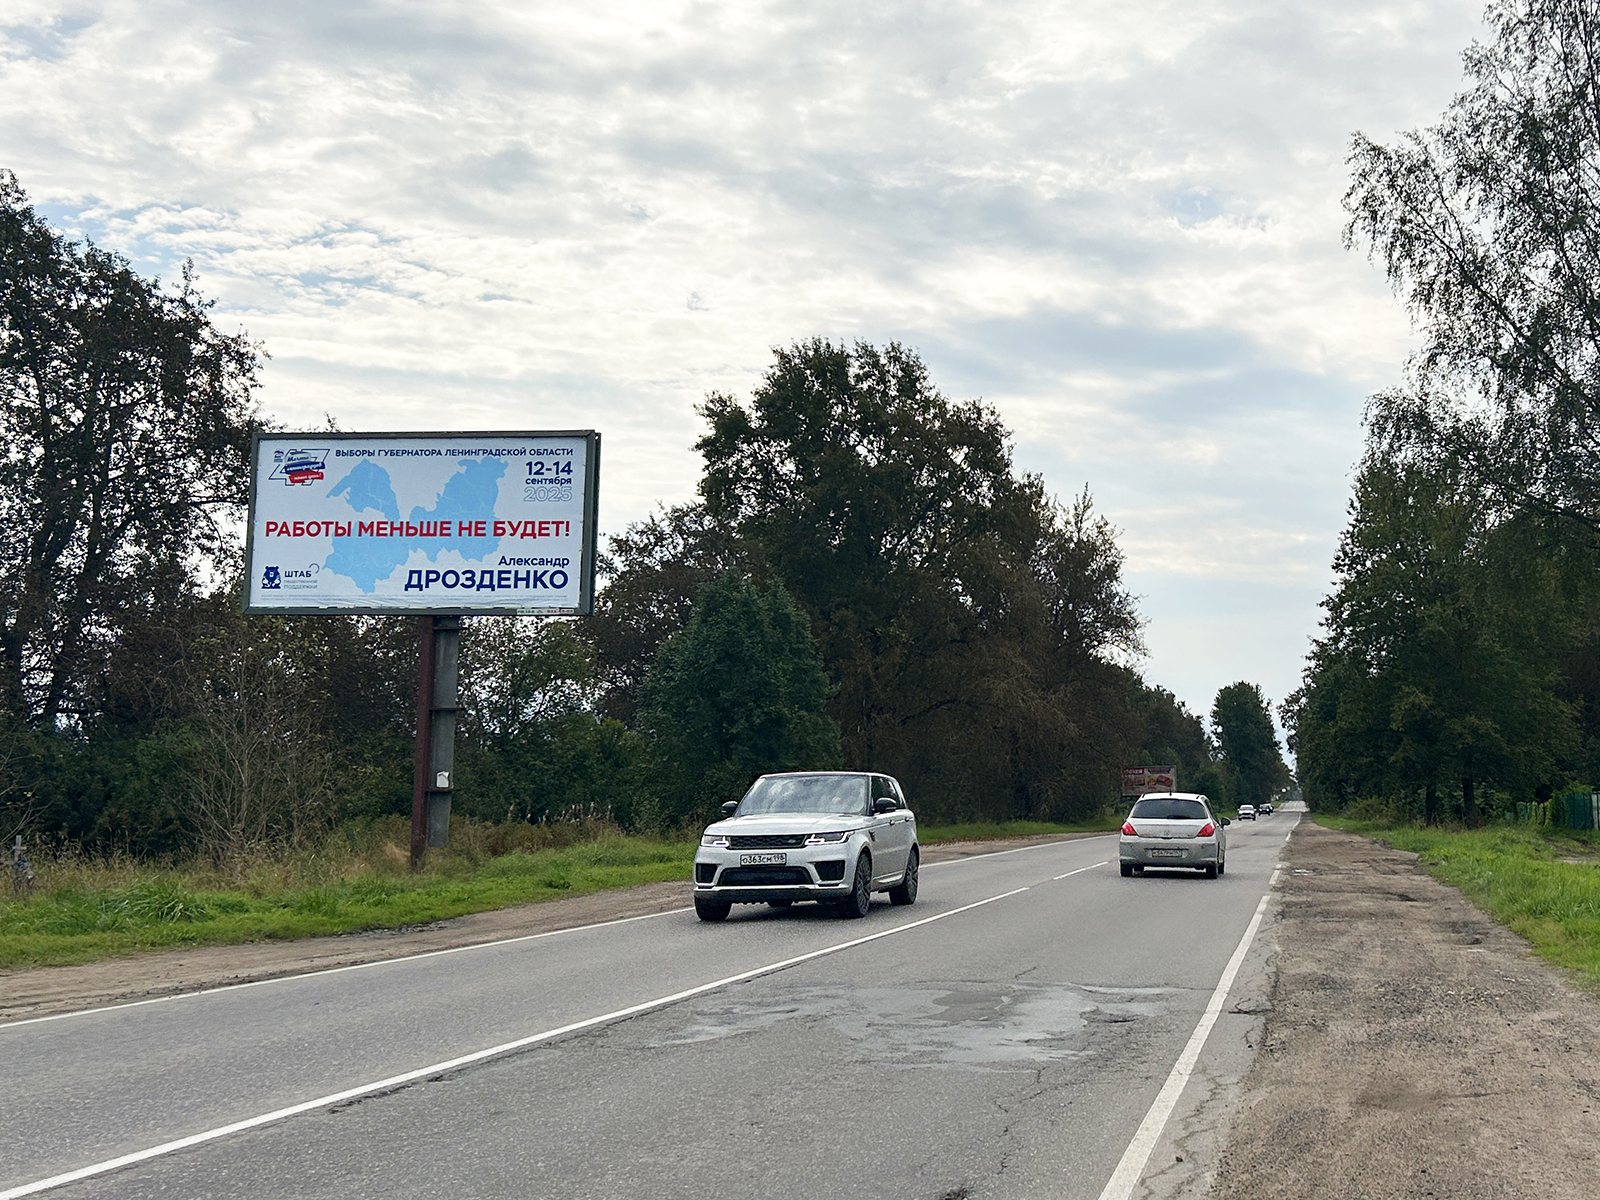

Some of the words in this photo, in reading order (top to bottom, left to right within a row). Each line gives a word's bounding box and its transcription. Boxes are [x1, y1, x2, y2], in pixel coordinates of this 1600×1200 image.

[335, 449, 376, 457] ВЫБОРЫ
[378, 449, 443, 457] ГУБЕРНАТОРА
[444, 447, 527, 457] ЛЕНИНГРАДСКОЙ
[529, 448, 574, 456] ОБЛАСТИ
[525, 460, 573, 475] 12-14
[525, 476, 572, 486] сентября
[523, 486, 573, 502] 2025
[265, 521, 352, 537] РАБОТЫ
[358, 520, 452, 537] МЕНЬШЕ
[458, 520, 487, 537] НЕ
[493, 520, 570, 539] БУДЕТ!
[498, 555, 570, 568] Александр
[284, 570, 312, 578] ШТАБ
[404, 569, 569, 592] ДРОЗДЕНКО
